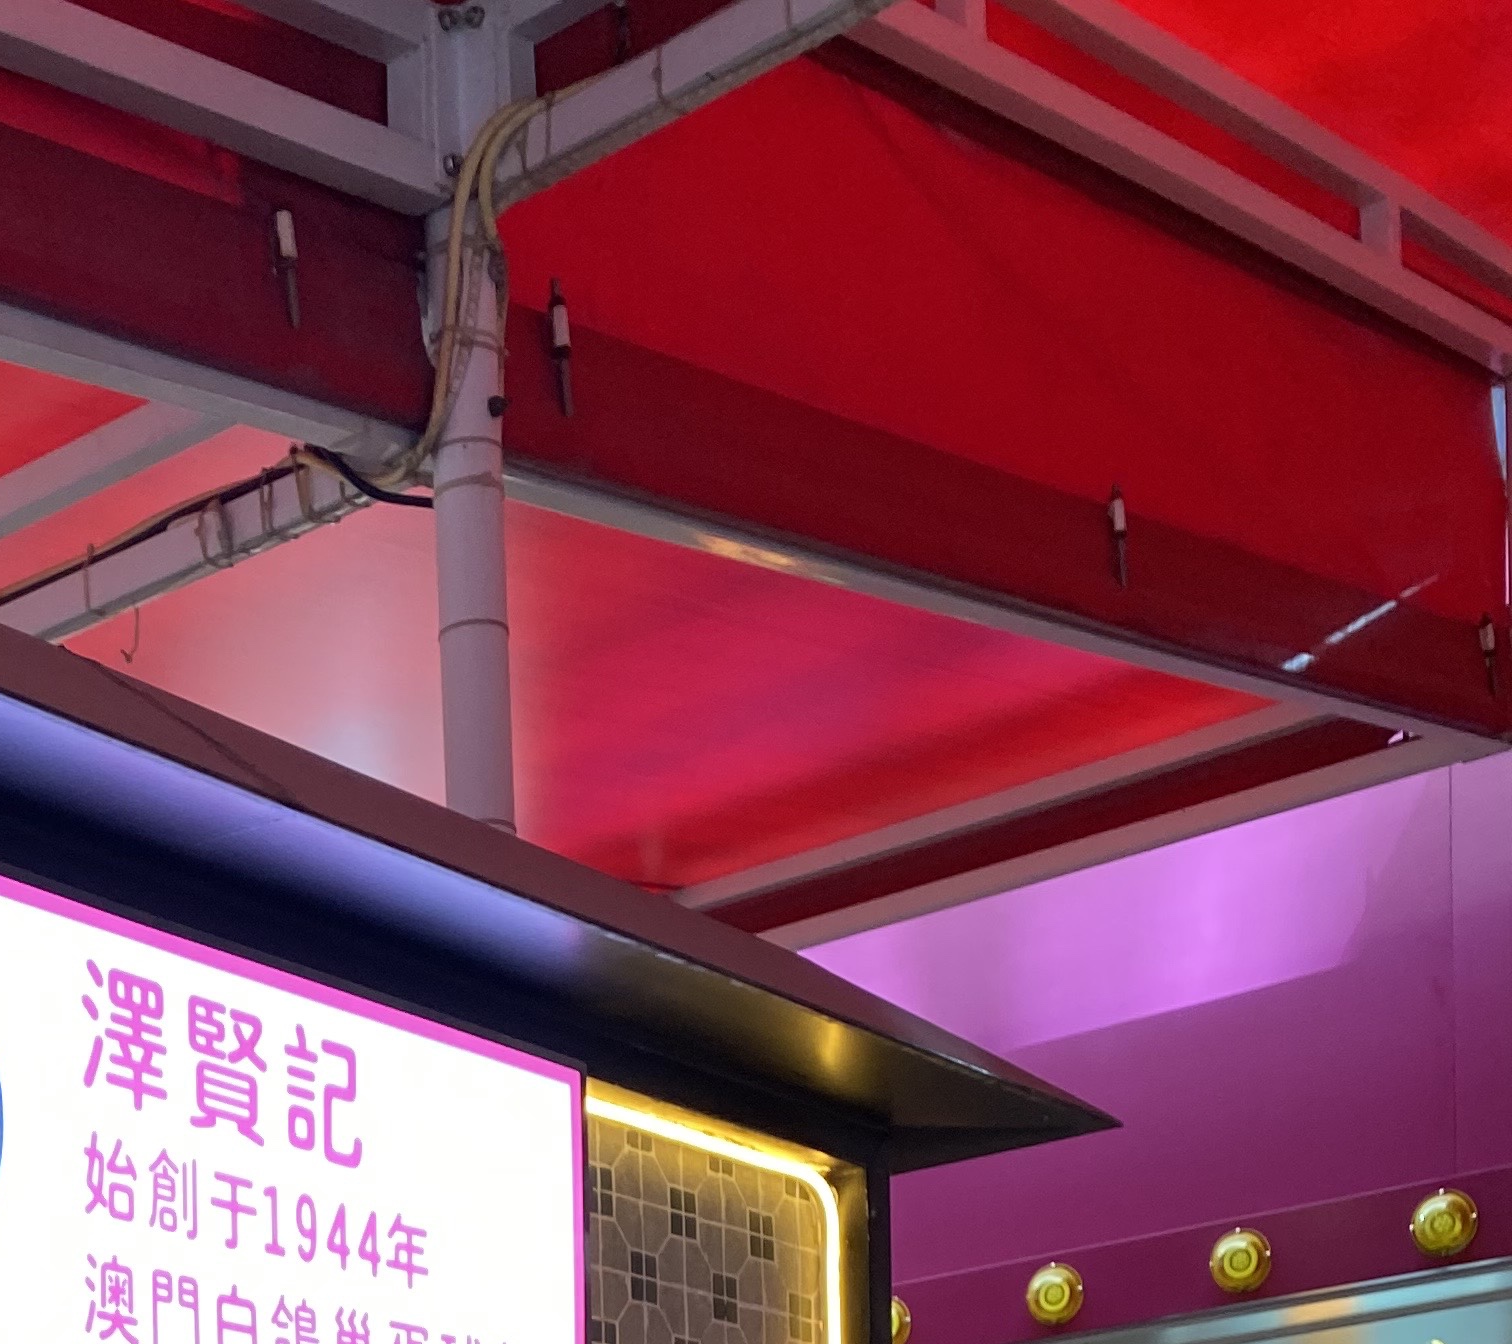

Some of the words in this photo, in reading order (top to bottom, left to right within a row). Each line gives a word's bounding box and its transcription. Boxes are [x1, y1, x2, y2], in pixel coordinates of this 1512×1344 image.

[82, 958, 364, 1170] 澤賢記
[83, 1130, 429, 1289] 始創于1944年
